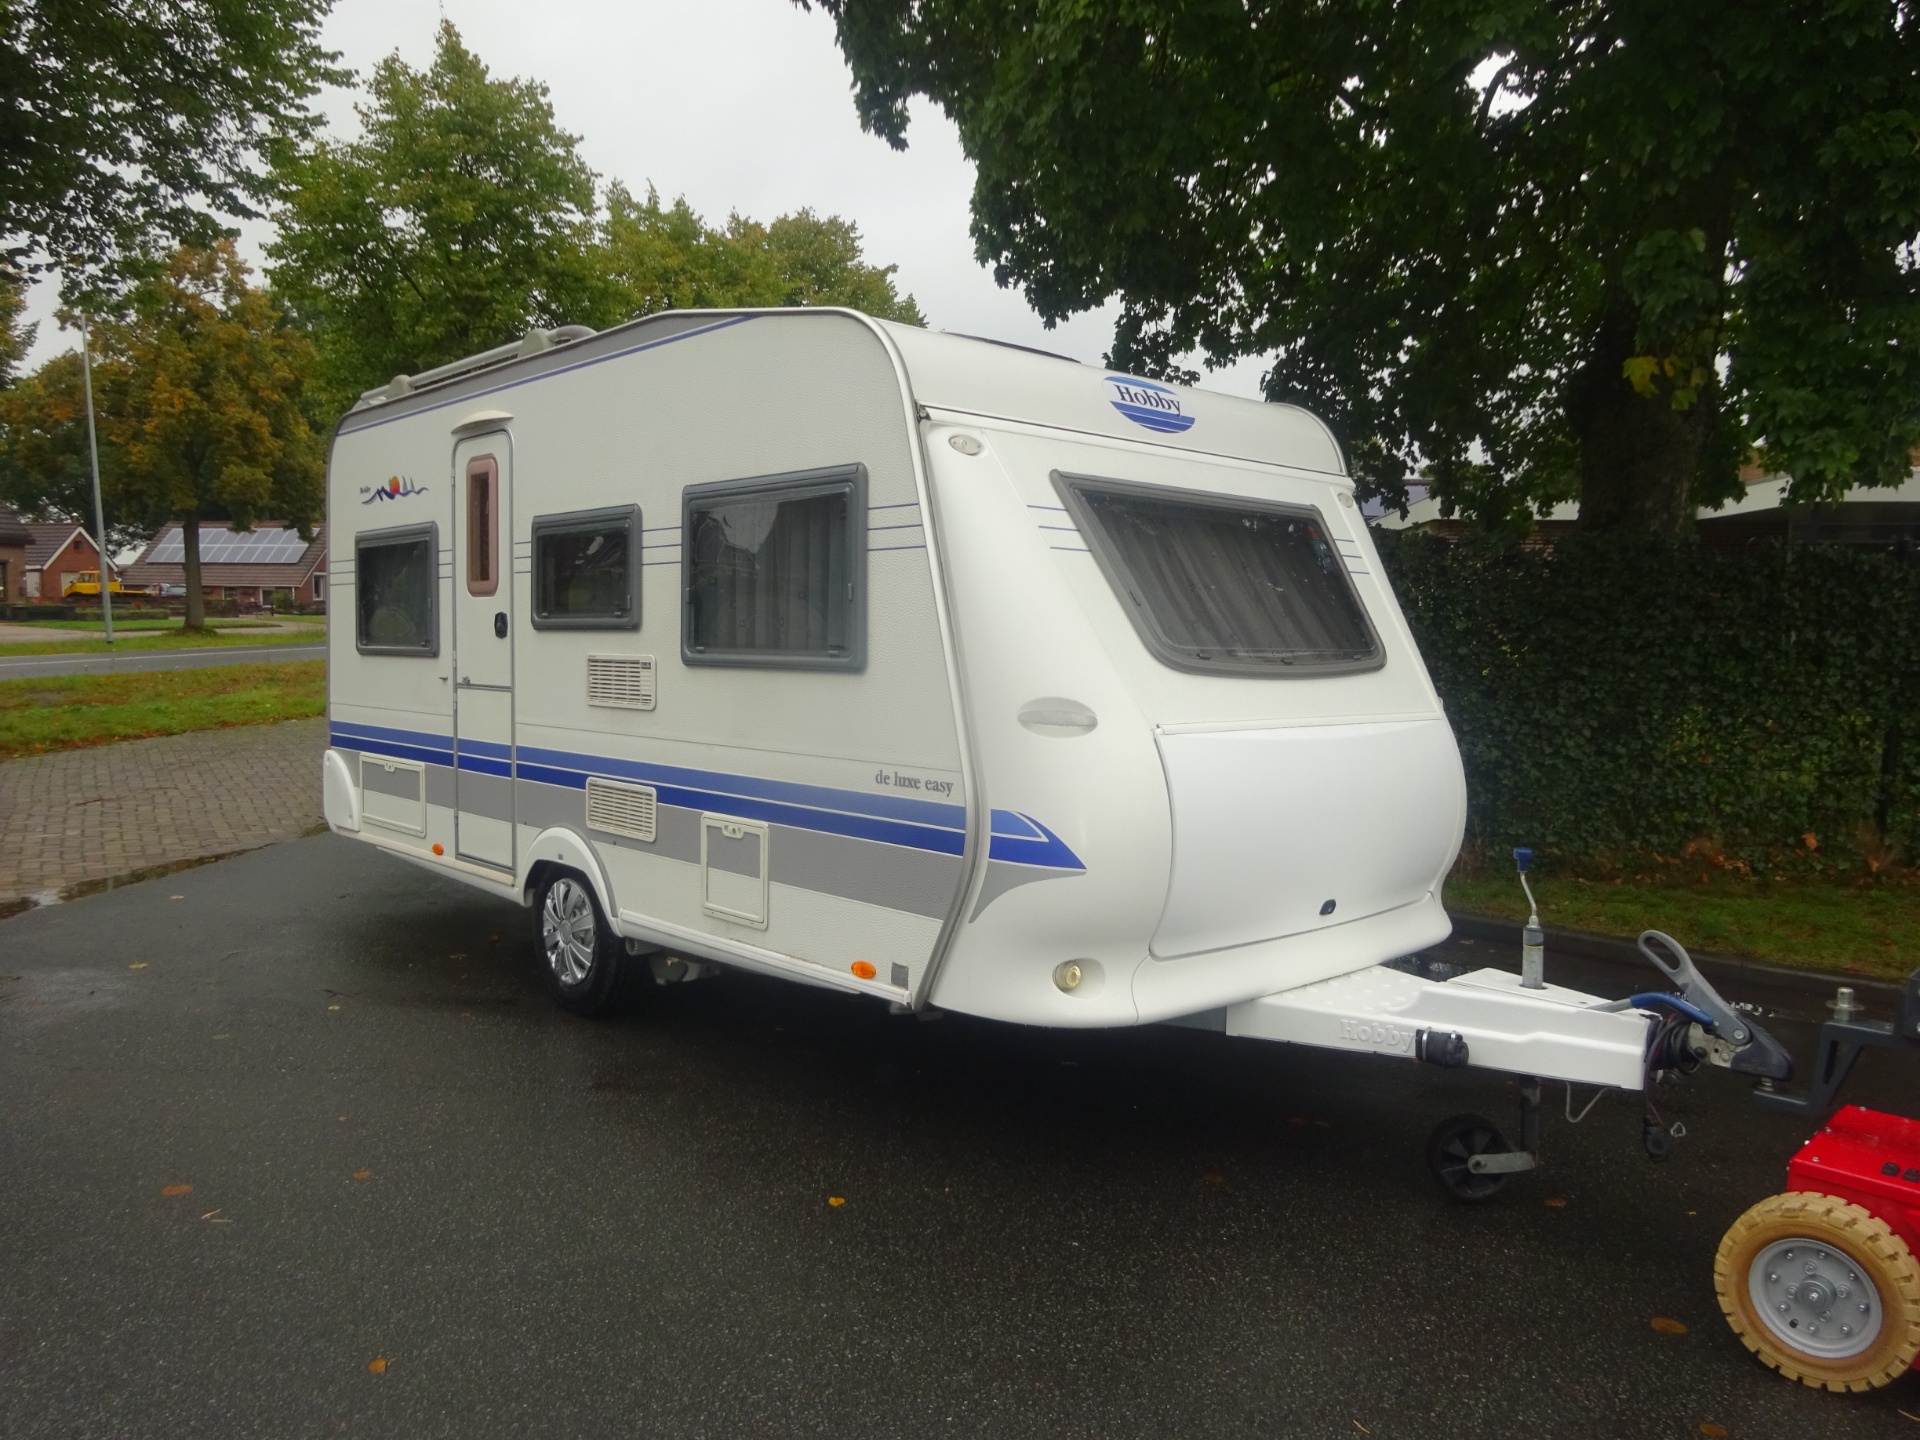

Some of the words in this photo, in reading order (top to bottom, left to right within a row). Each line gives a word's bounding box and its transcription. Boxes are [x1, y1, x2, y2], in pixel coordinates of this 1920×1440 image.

[1113, 384, 1181, 417] Hobby
[875, 769, 891, 785] de
[893, 771, 921, 789] luxe
[924, 779, 954, 797] easy
[1340, 1019, 1416, 1053] Hobby
